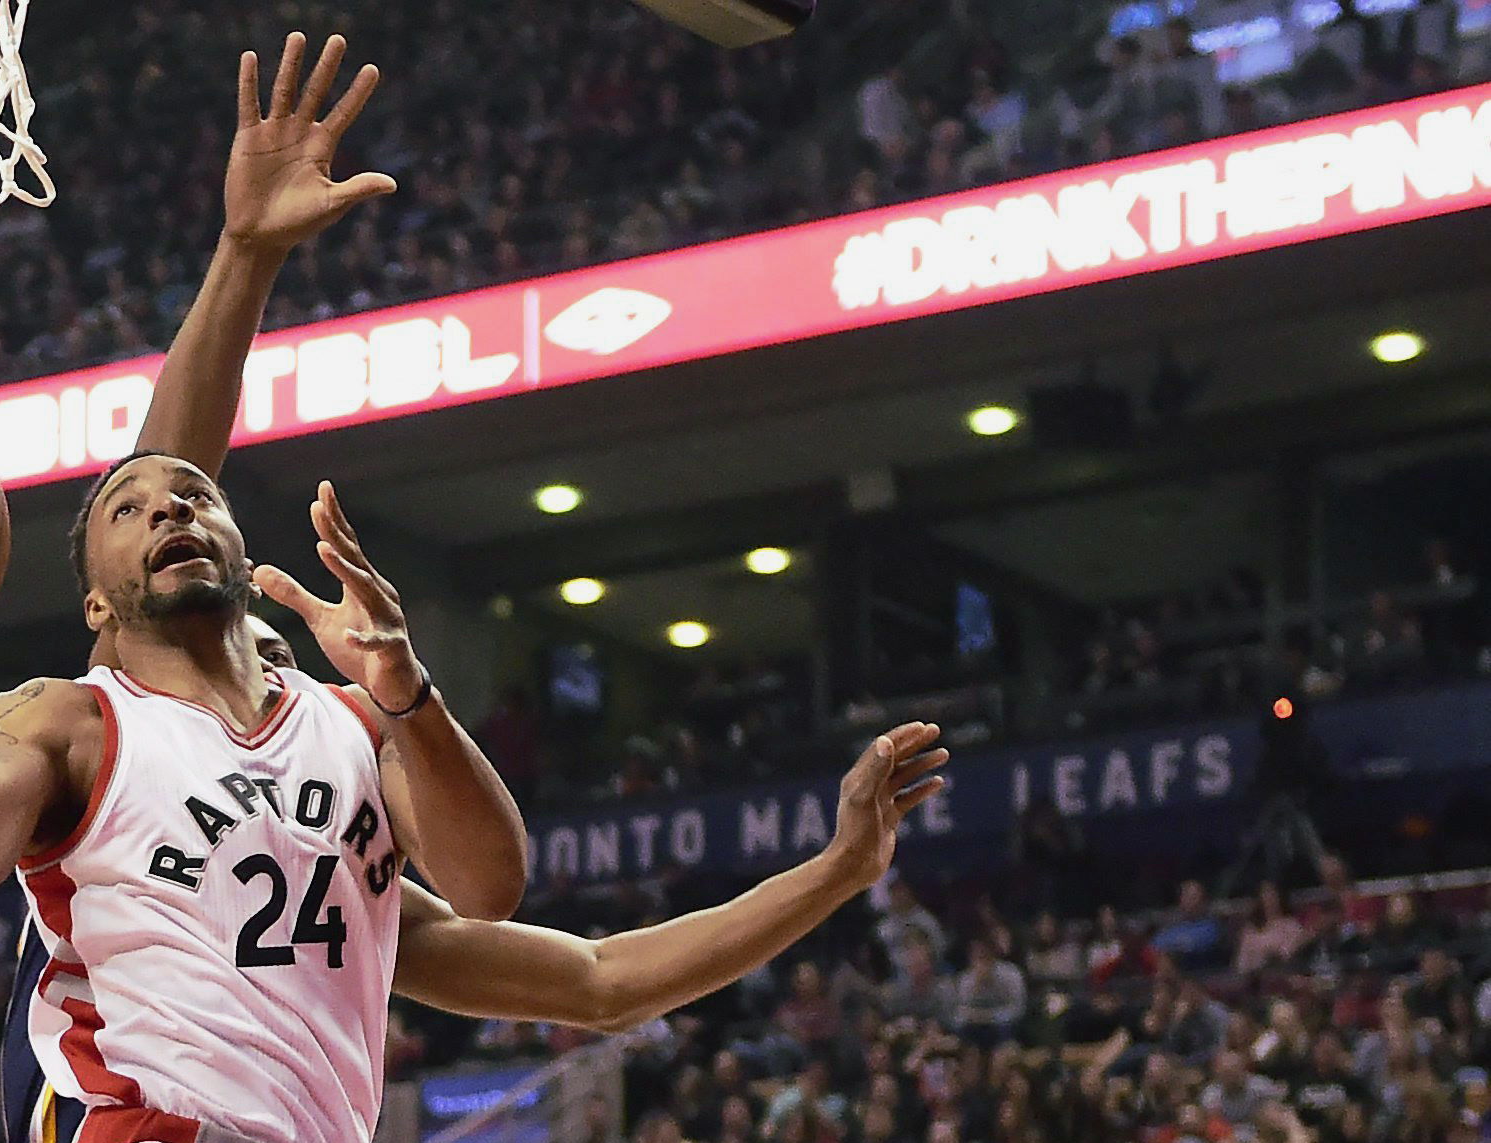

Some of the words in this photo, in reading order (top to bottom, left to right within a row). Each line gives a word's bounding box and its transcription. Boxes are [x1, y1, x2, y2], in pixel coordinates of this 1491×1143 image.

[146, 771, 397, 899] RAPTORS
[528, 808, 706, 879] ONTO
[739, 773, 954, 855] MAE
[232, 853, 347, 969] 24
